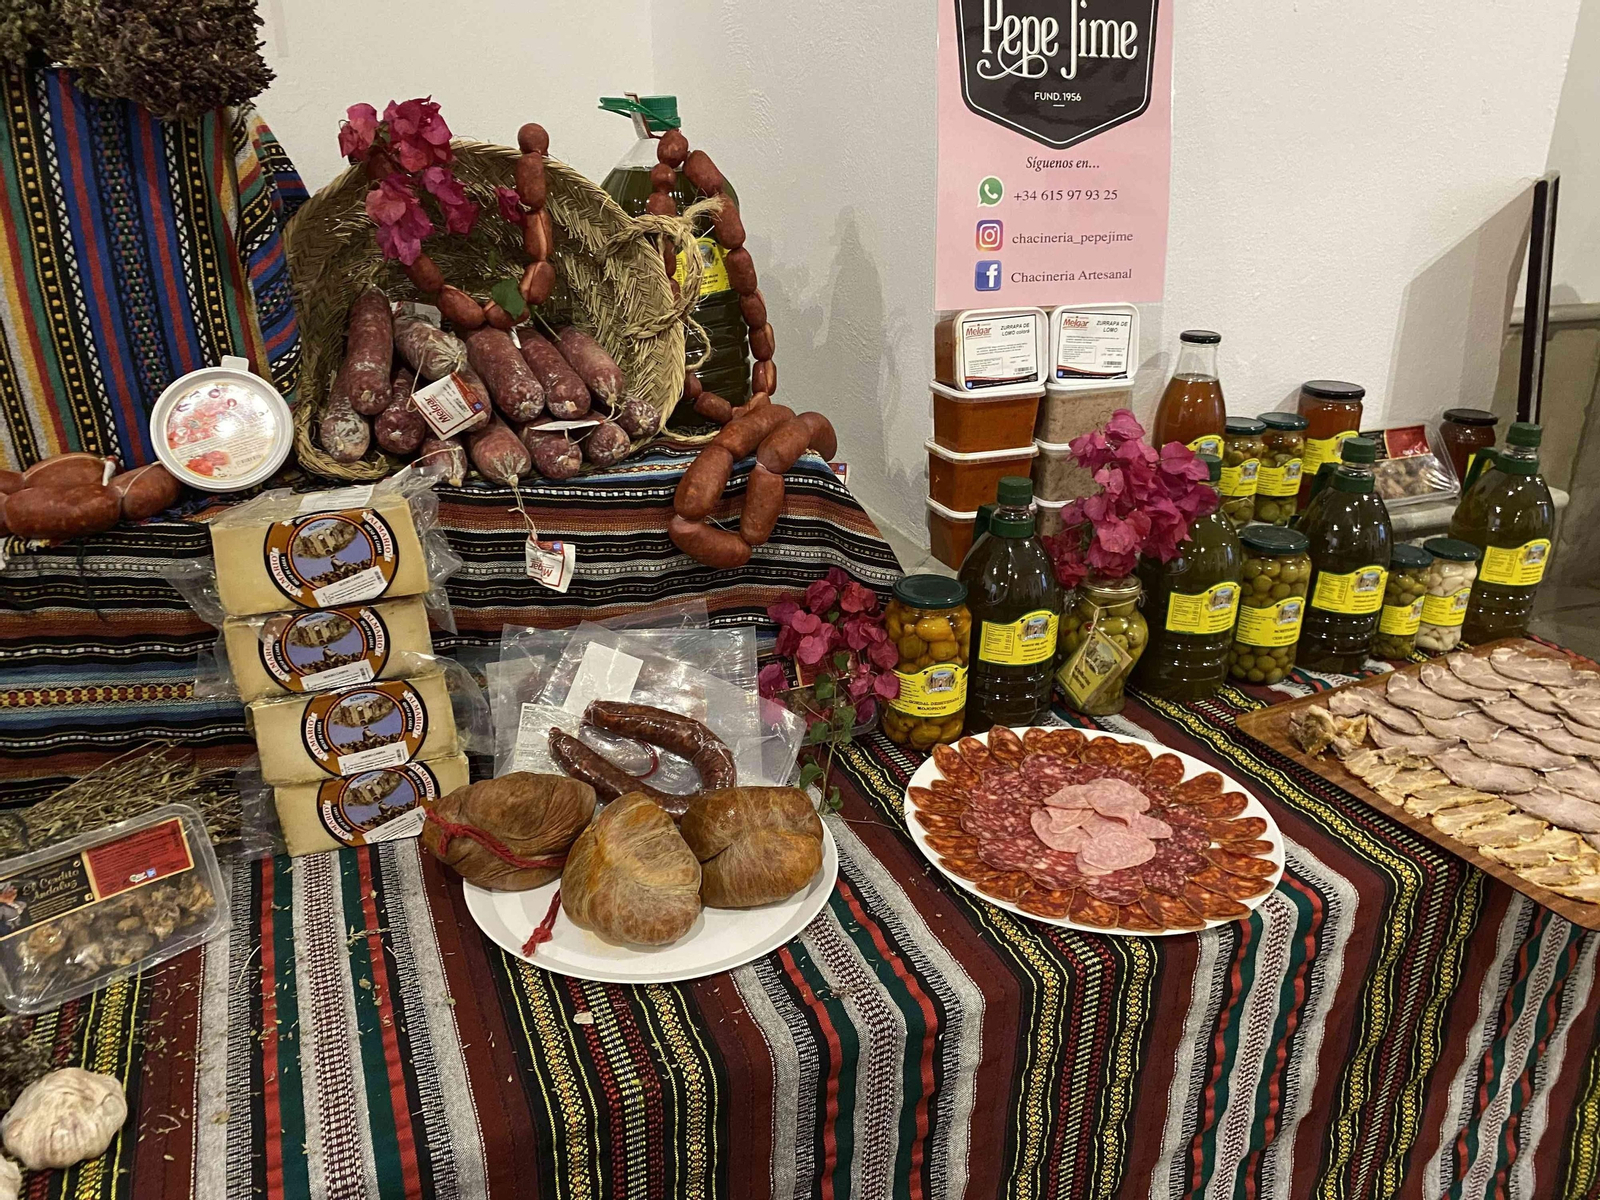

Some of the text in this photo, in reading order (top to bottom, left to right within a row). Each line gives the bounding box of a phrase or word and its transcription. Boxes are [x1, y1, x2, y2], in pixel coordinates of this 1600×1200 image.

[976, 0, 1138, 79] Pepe Jime
[1025, 156, 1074, 172] Síguenos
[1013, 190, 1118, 201] +34 615 97 93 25
[1012, 231, 1133, 246] chacineria_pepejime
[1011, 268, 1132, 283] Chacineria Artesanal
[1000, 323, 1022, 332] ZURRAPA
[1063, 317, 1090, 329] Melgar
[1096, 320, 1128, 328] ZURRAPA DE
[965, 325, 992, 339] Melgar
[424, 397, 451, 424] Melgar
